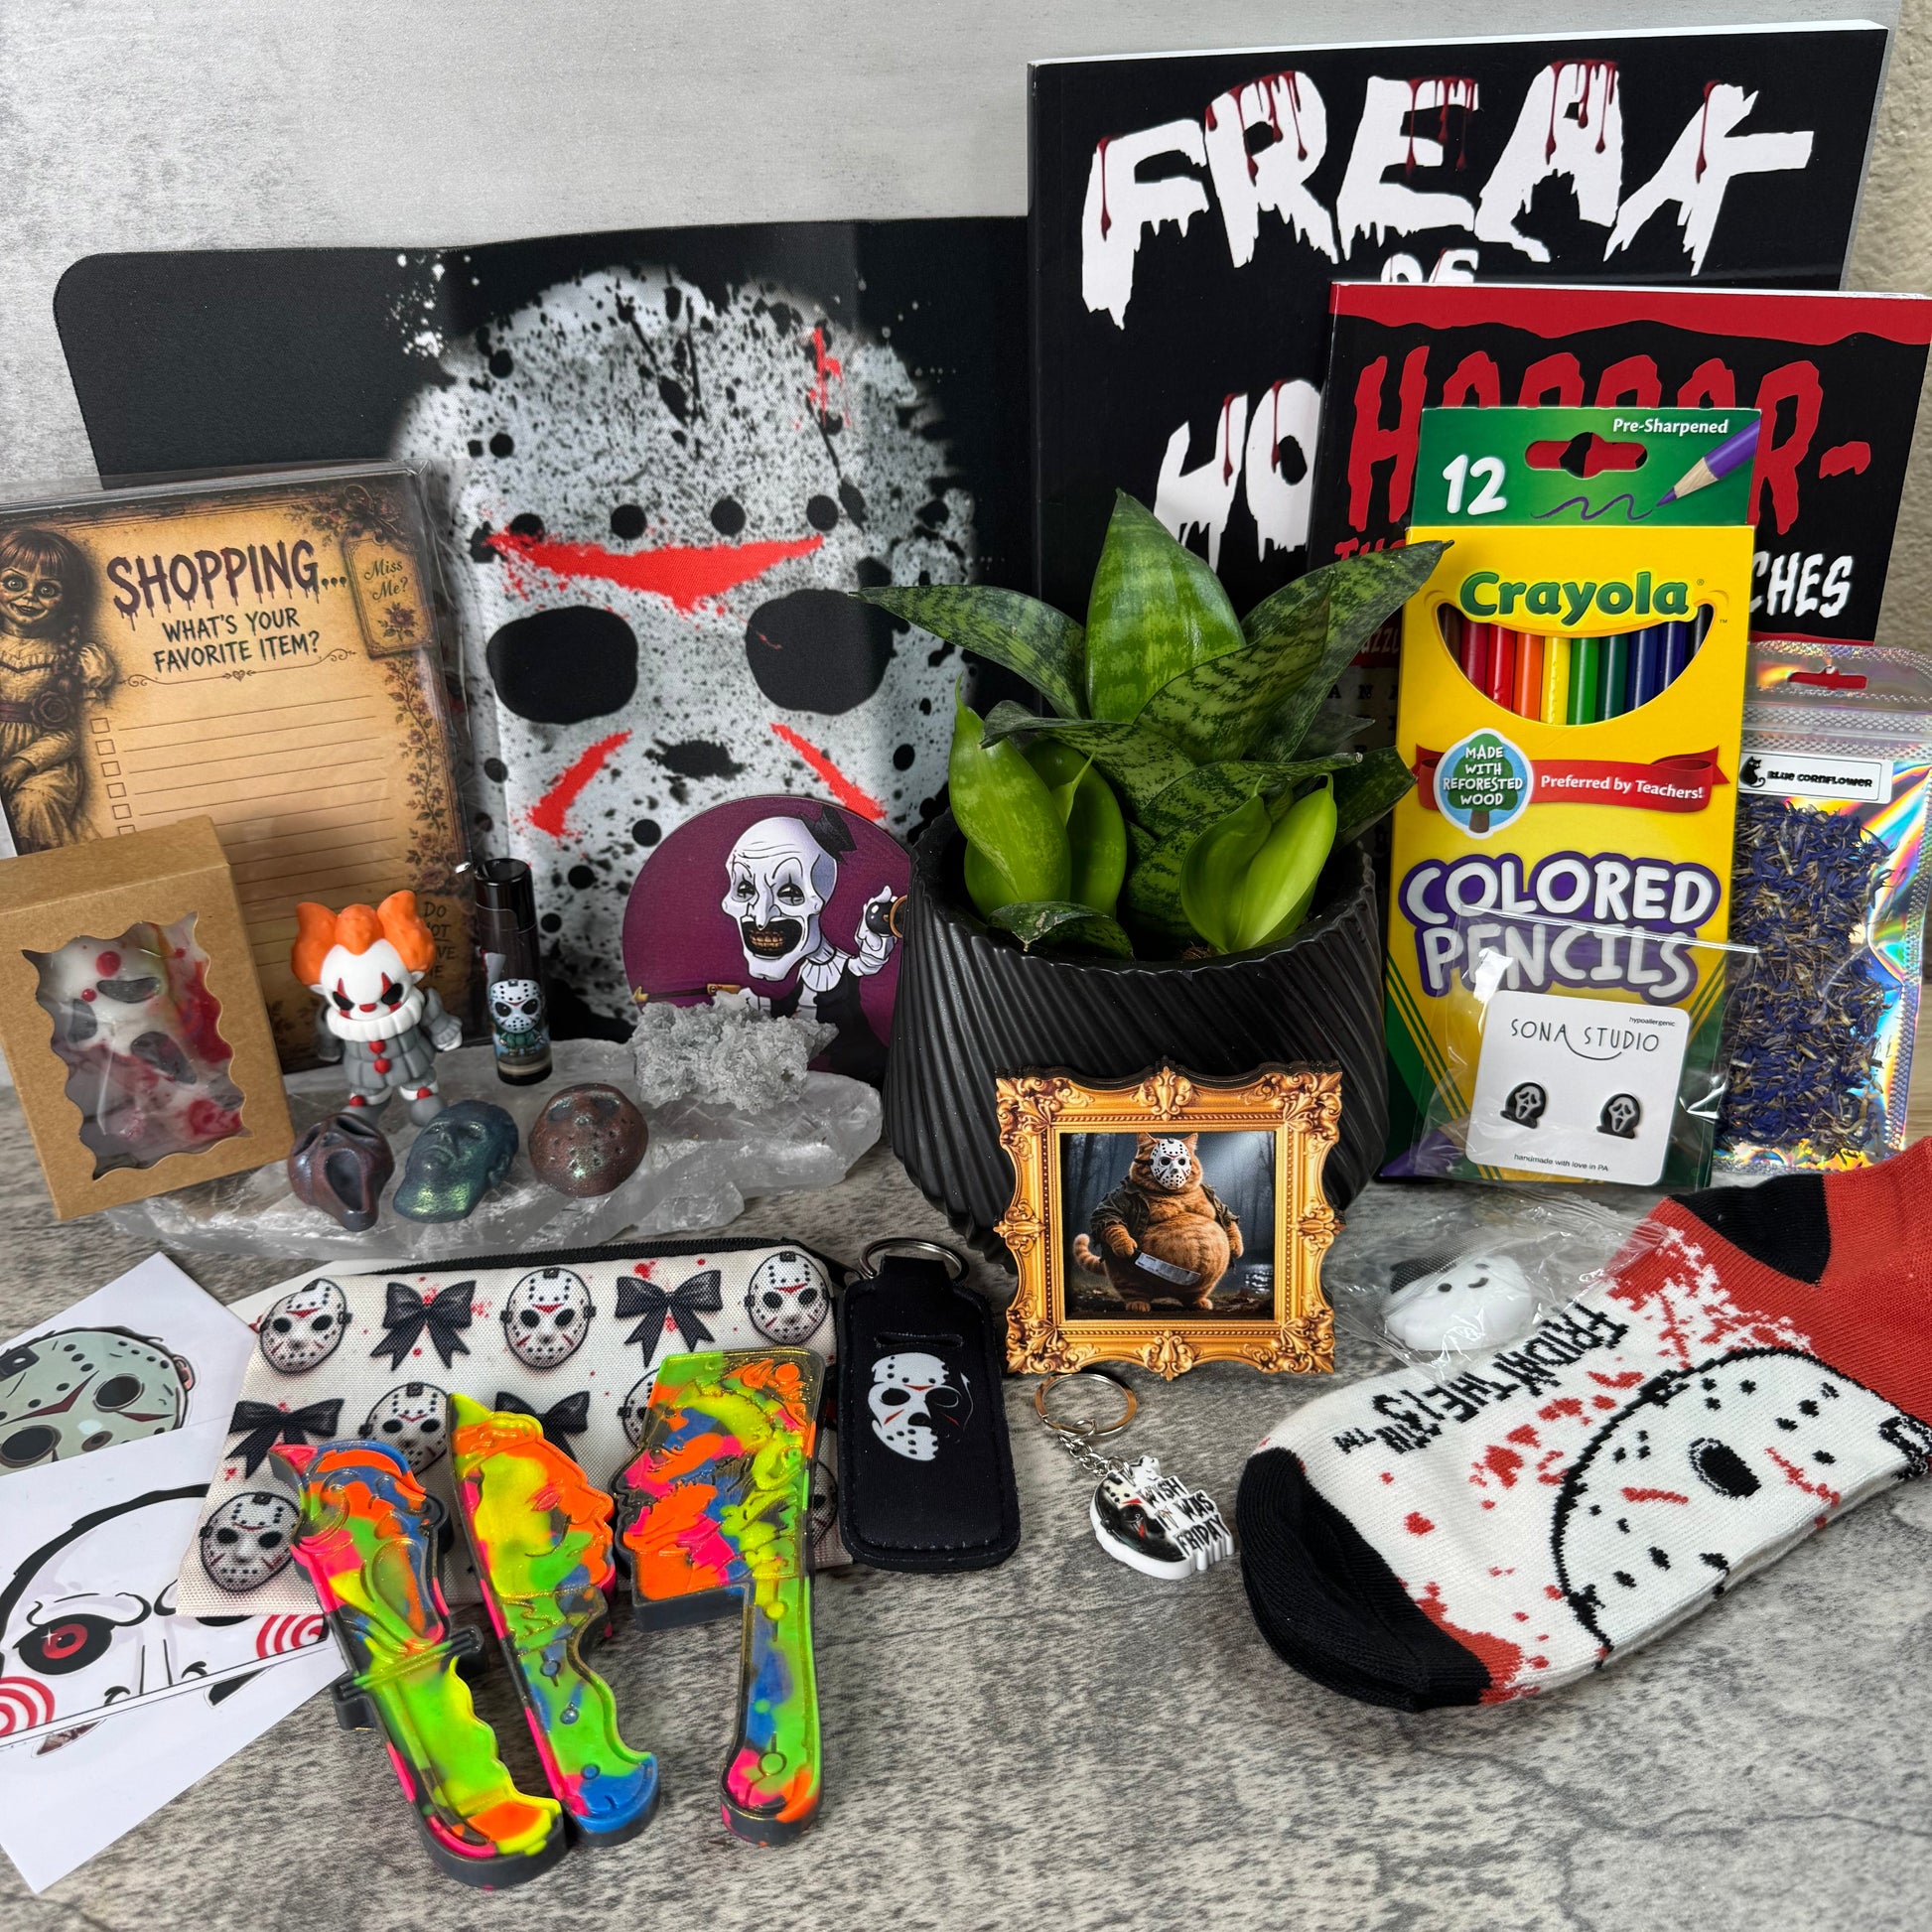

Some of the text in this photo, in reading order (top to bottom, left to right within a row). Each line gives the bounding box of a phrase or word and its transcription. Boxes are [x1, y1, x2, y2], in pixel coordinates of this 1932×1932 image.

[1081, 60, 1814, 331] FREAK
[1612, 418, 1729, 437] Pre-Sharpened
[1442, 454, 1507, 515] 12
[363, 559, 403, 581] Miss
[371, 577, 409, 601] Me?
[1459, 571, 1689, 626] Crayola
[162, 608, 301, 642] WHAT'S YOUR
[154, 630, 321, 673] FAVORITE ITEM?
[1464, 745, 1504, 759] MADE
[1465, 761, 1502, 775] WITH
[1443, 776, 1523, 791] REFORESTED
[1460, 792, 1503, 806] WOOD
[1541, 774, 1704, 799] Preferred by Teachers!
[1406, 858, 1714, 925] COLORED
[1422, 923, 1690, 999] PENCILS
[1629, 1016, 1676, 1027] hypoallergenic
[1584, 1027, 1659, 1052] STUDIO
[1514, 1153, 1553, 1165] handmade
[1555, 1159, 1570, 1168] with
[1572, 1161, 1587, 1170] love
[1491, 1299, 1629, 1397] FRIDAY
[1422, 1371, 1520, 1423] THE
[1136, 1476, 1187, 1510] WISH
[1173, 1490, 1214, 1523] WAS
[1173, 1514, 1231, 1557] FRIDAY
